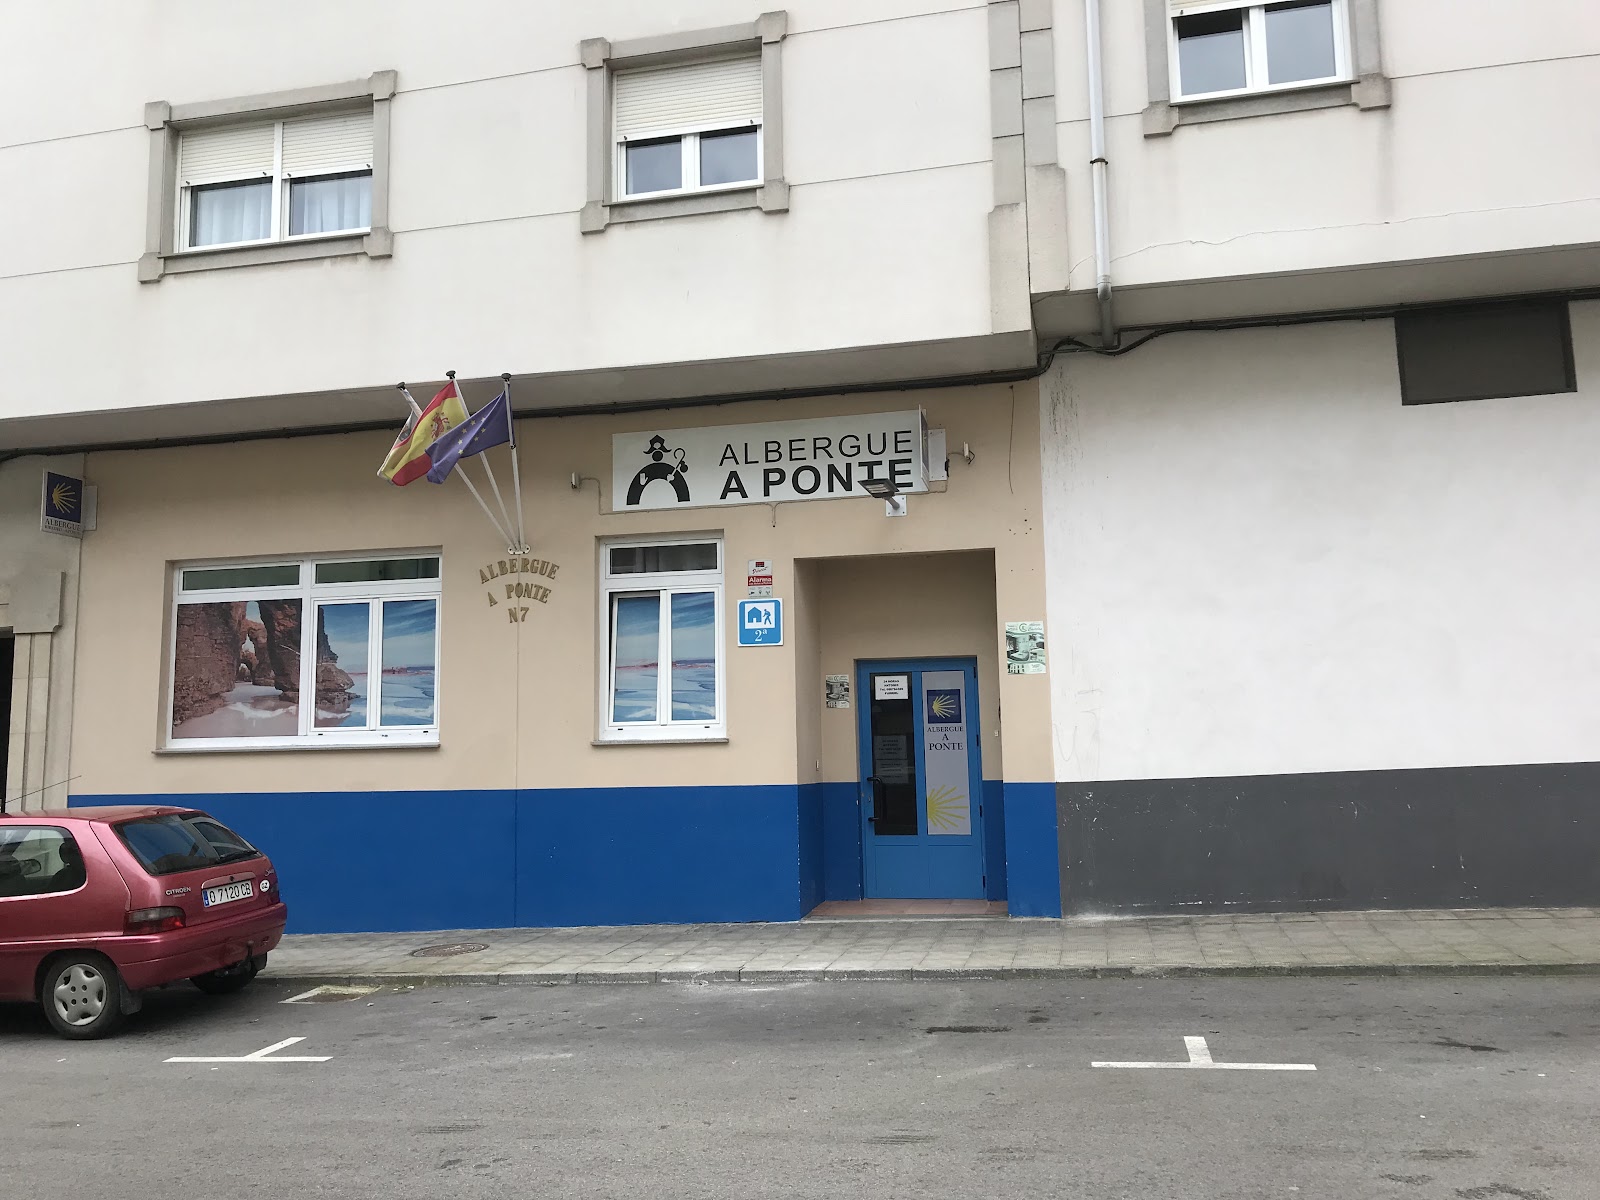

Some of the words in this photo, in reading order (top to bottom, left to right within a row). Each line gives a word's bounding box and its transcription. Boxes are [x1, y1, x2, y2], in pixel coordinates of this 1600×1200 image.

[719, 429, 913, 467] ALBERGUE
[719, 470, 749, 500] A
[762, 457, 914, 498] PONTE
[44, 518, 81, 531] ALBERGUE
[479, 557, 560, 585] ALBERGUE
[749, 576, 772, 584] Alarma
[487, 591, 498, 608] A
[504, 582, 552, 604] PONTE
[928, 742, 964, 751] PONTE
[941, 733, 950, 741] A
[217, 885, 240, 902] 7120
[240, 882, 252, 896] CB
